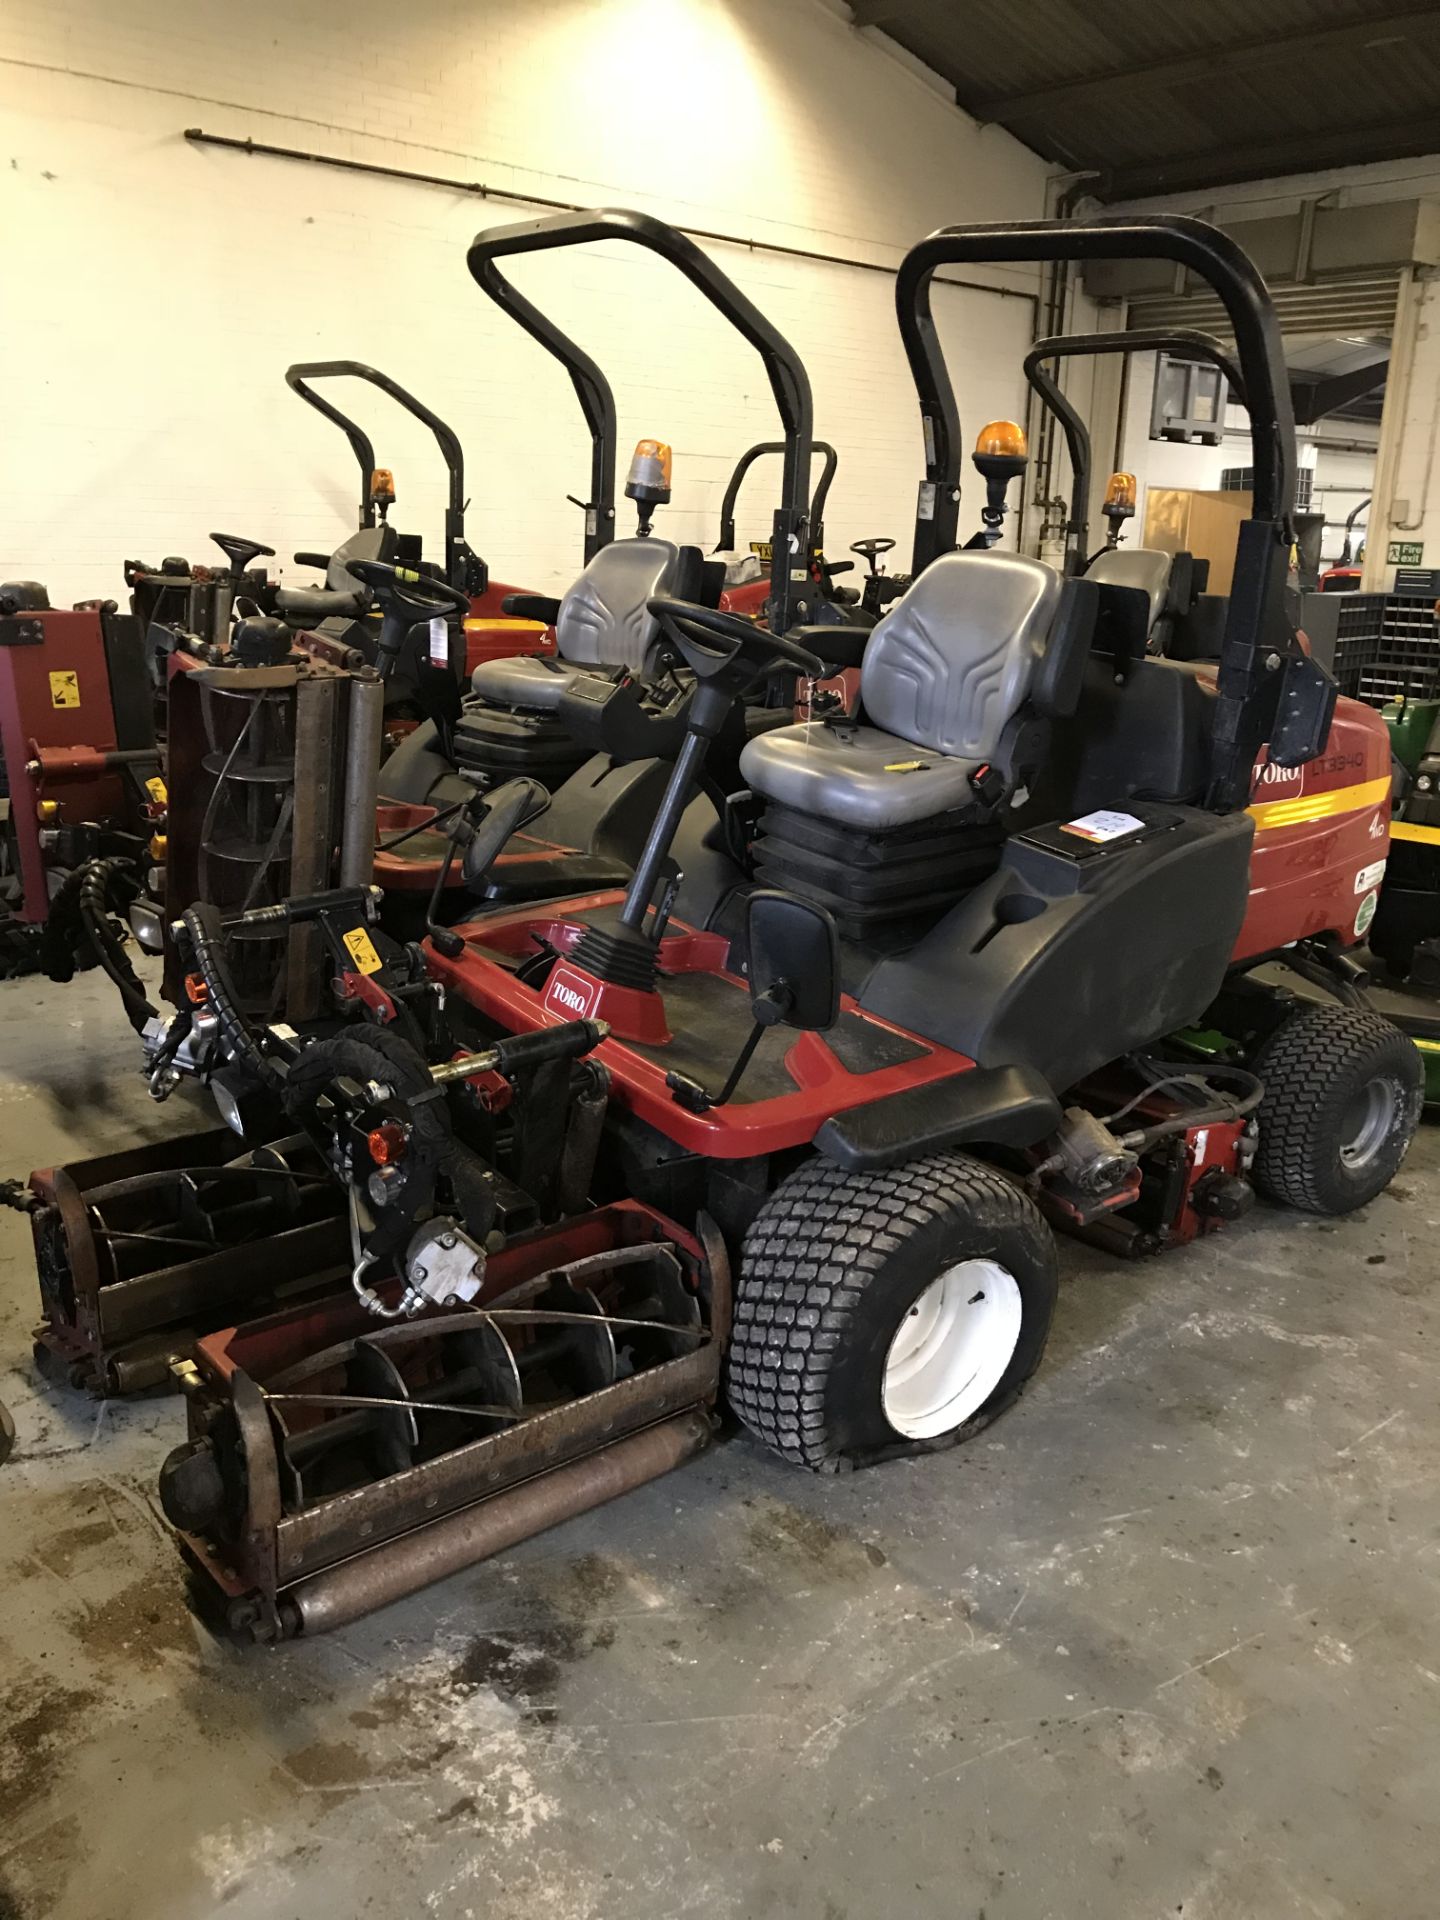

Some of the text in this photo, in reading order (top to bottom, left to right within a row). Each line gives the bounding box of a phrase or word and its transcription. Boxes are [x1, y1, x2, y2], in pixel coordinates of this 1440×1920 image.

[1400, 554, 1419, 563] exit
[1402, 545, 1422, 554] Fire
[1253, 763, 1299, 785] TORO
[1312, 752, 1365, 776] LT3340
[552, 982, 585, 1012] TORO
